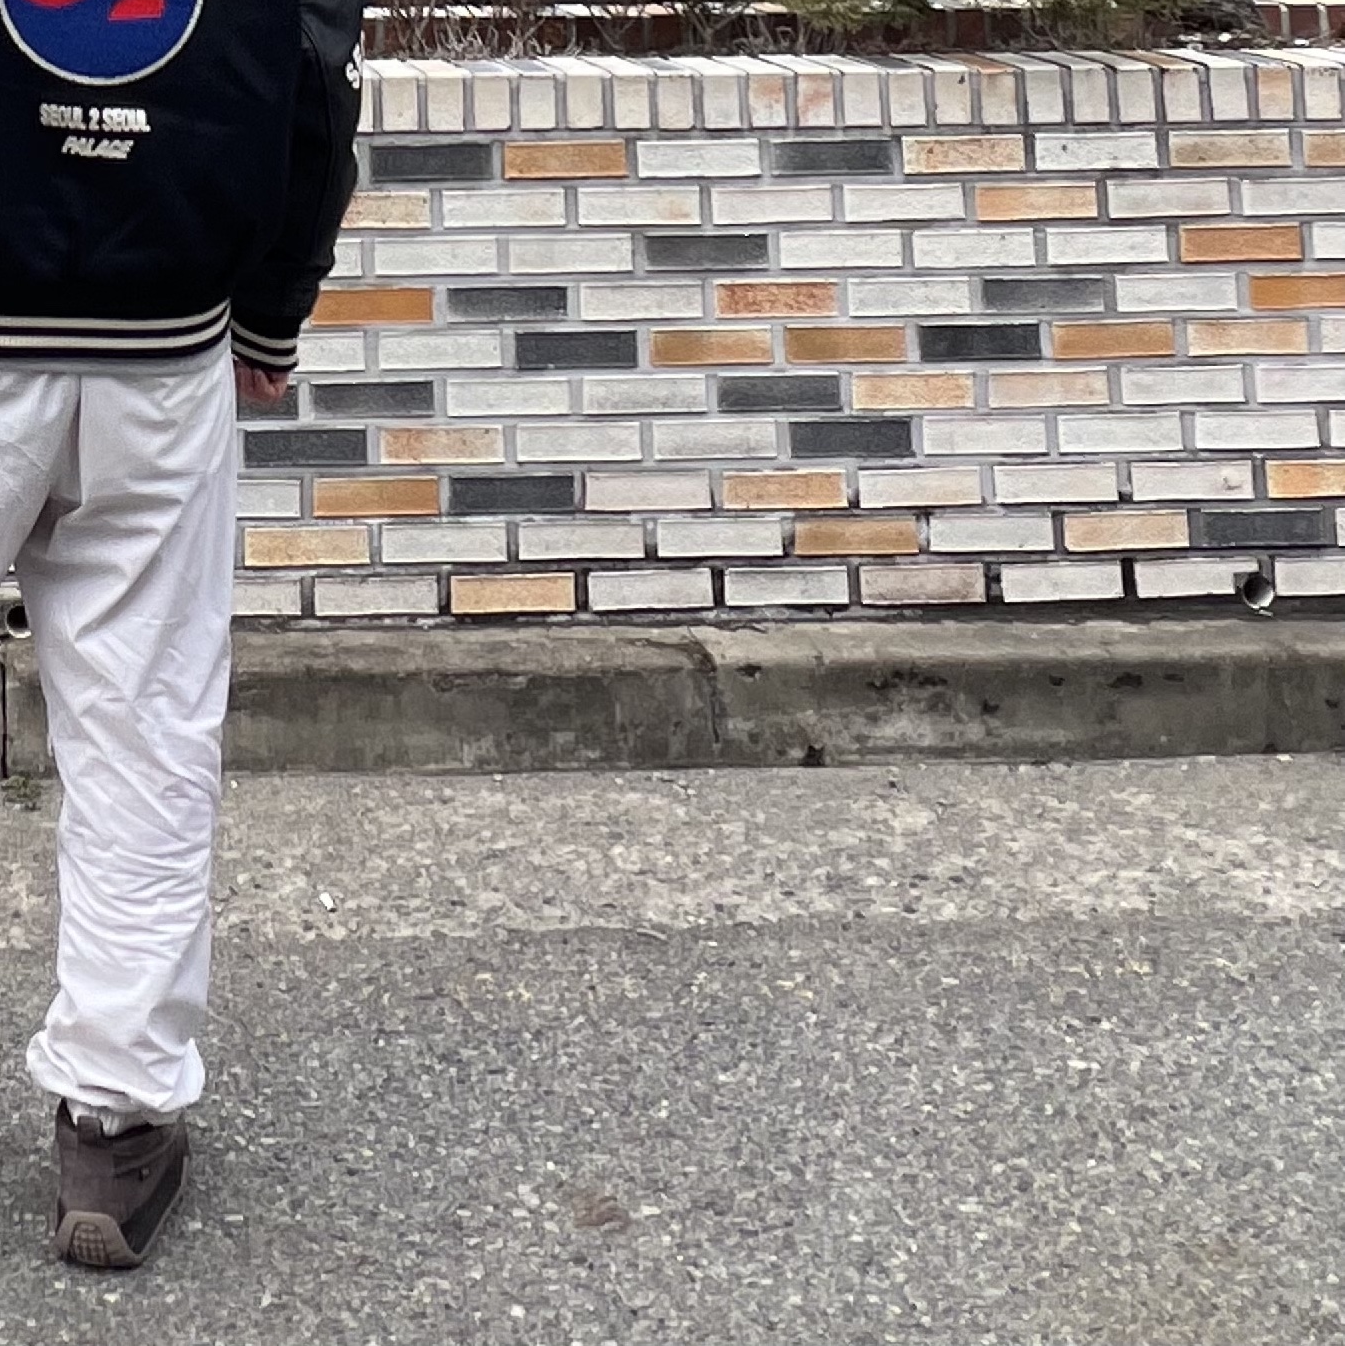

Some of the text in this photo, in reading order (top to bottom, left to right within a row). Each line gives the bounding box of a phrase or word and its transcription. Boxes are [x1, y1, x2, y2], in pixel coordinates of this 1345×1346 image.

[39, 103, 152, 133] SEOUL 2 SEOUL
